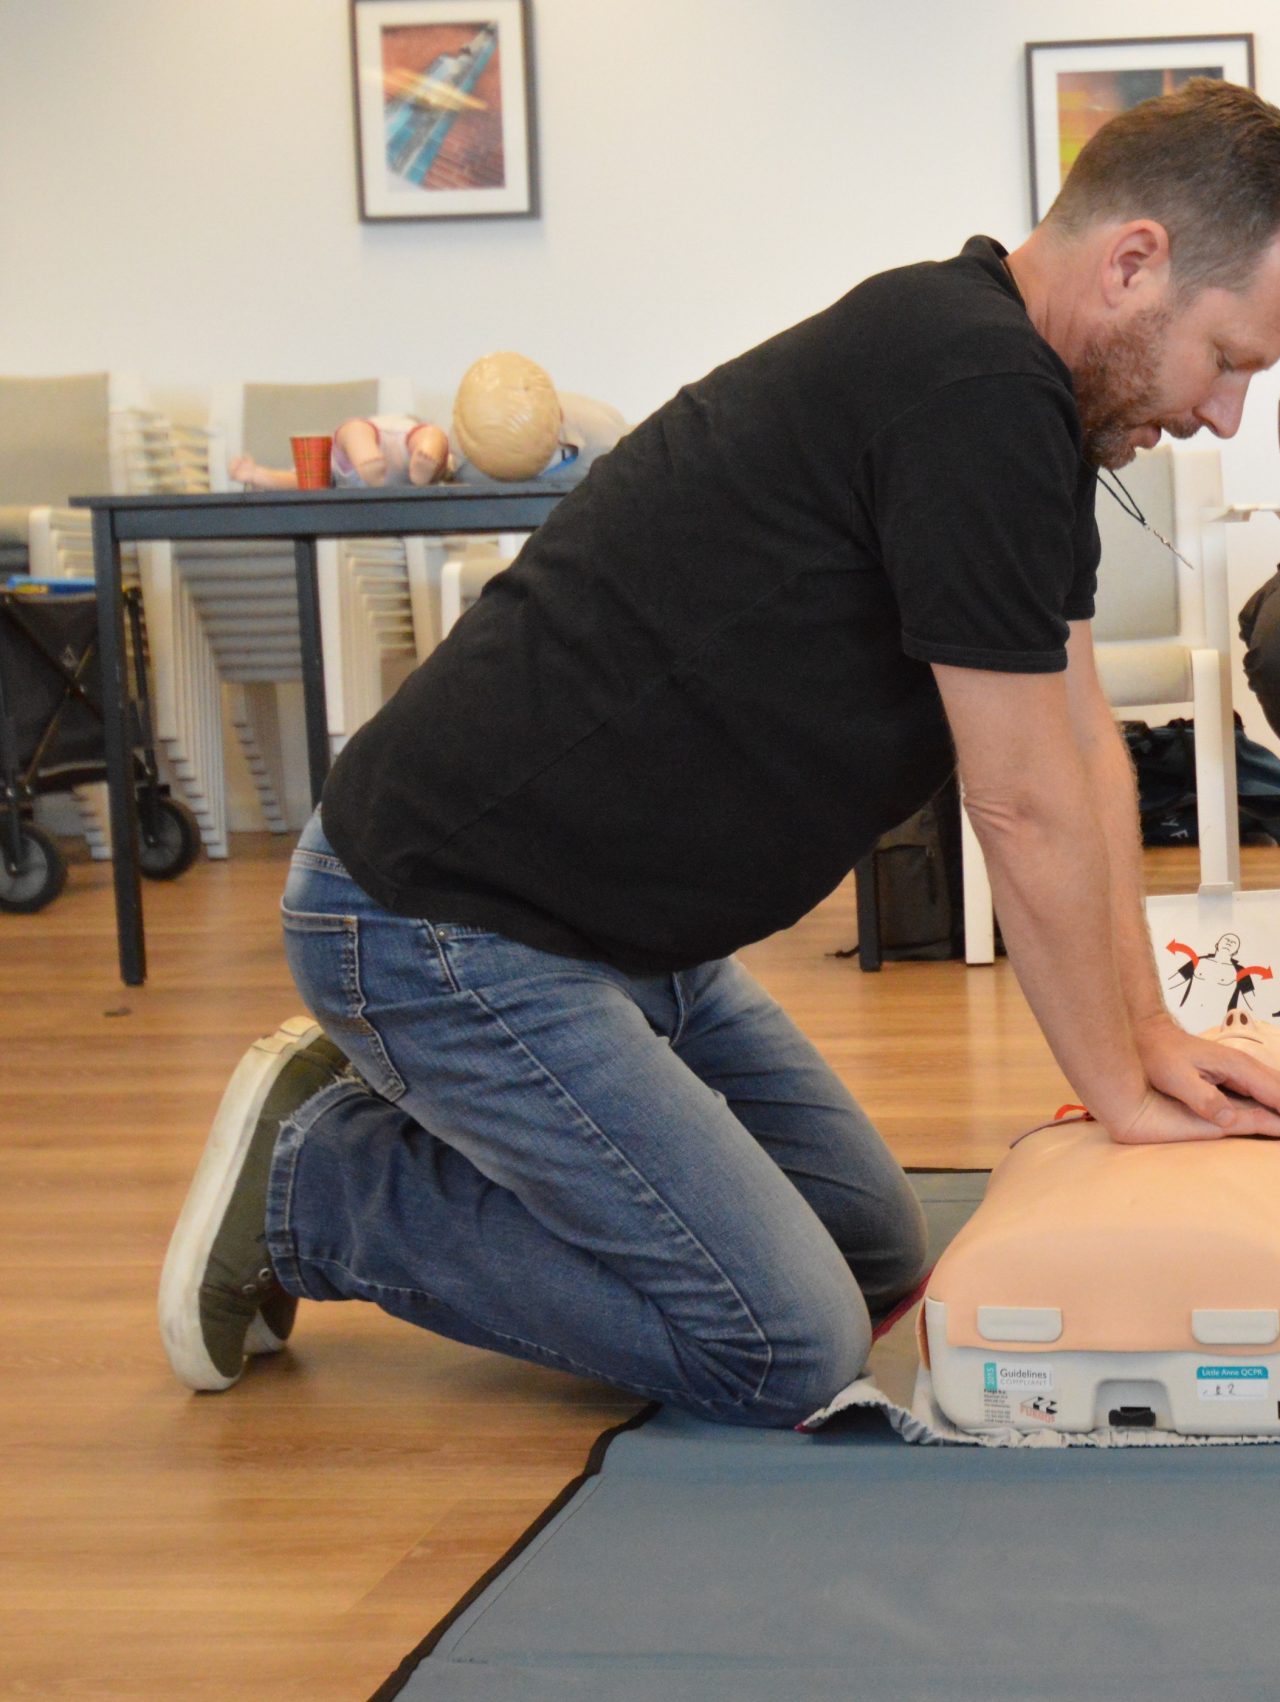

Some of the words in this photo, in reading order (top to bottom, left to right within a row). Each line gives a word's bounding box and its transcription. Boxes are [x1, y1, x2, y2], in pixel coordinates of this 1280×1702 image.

[1000, 1368, 1047, 1379] Guidelines
[1201, 1369, 1219, 1377] Little
[1221, 1369, 1239, 1377] Anne
[1240, 1368, 1263, 1377] QCPR
